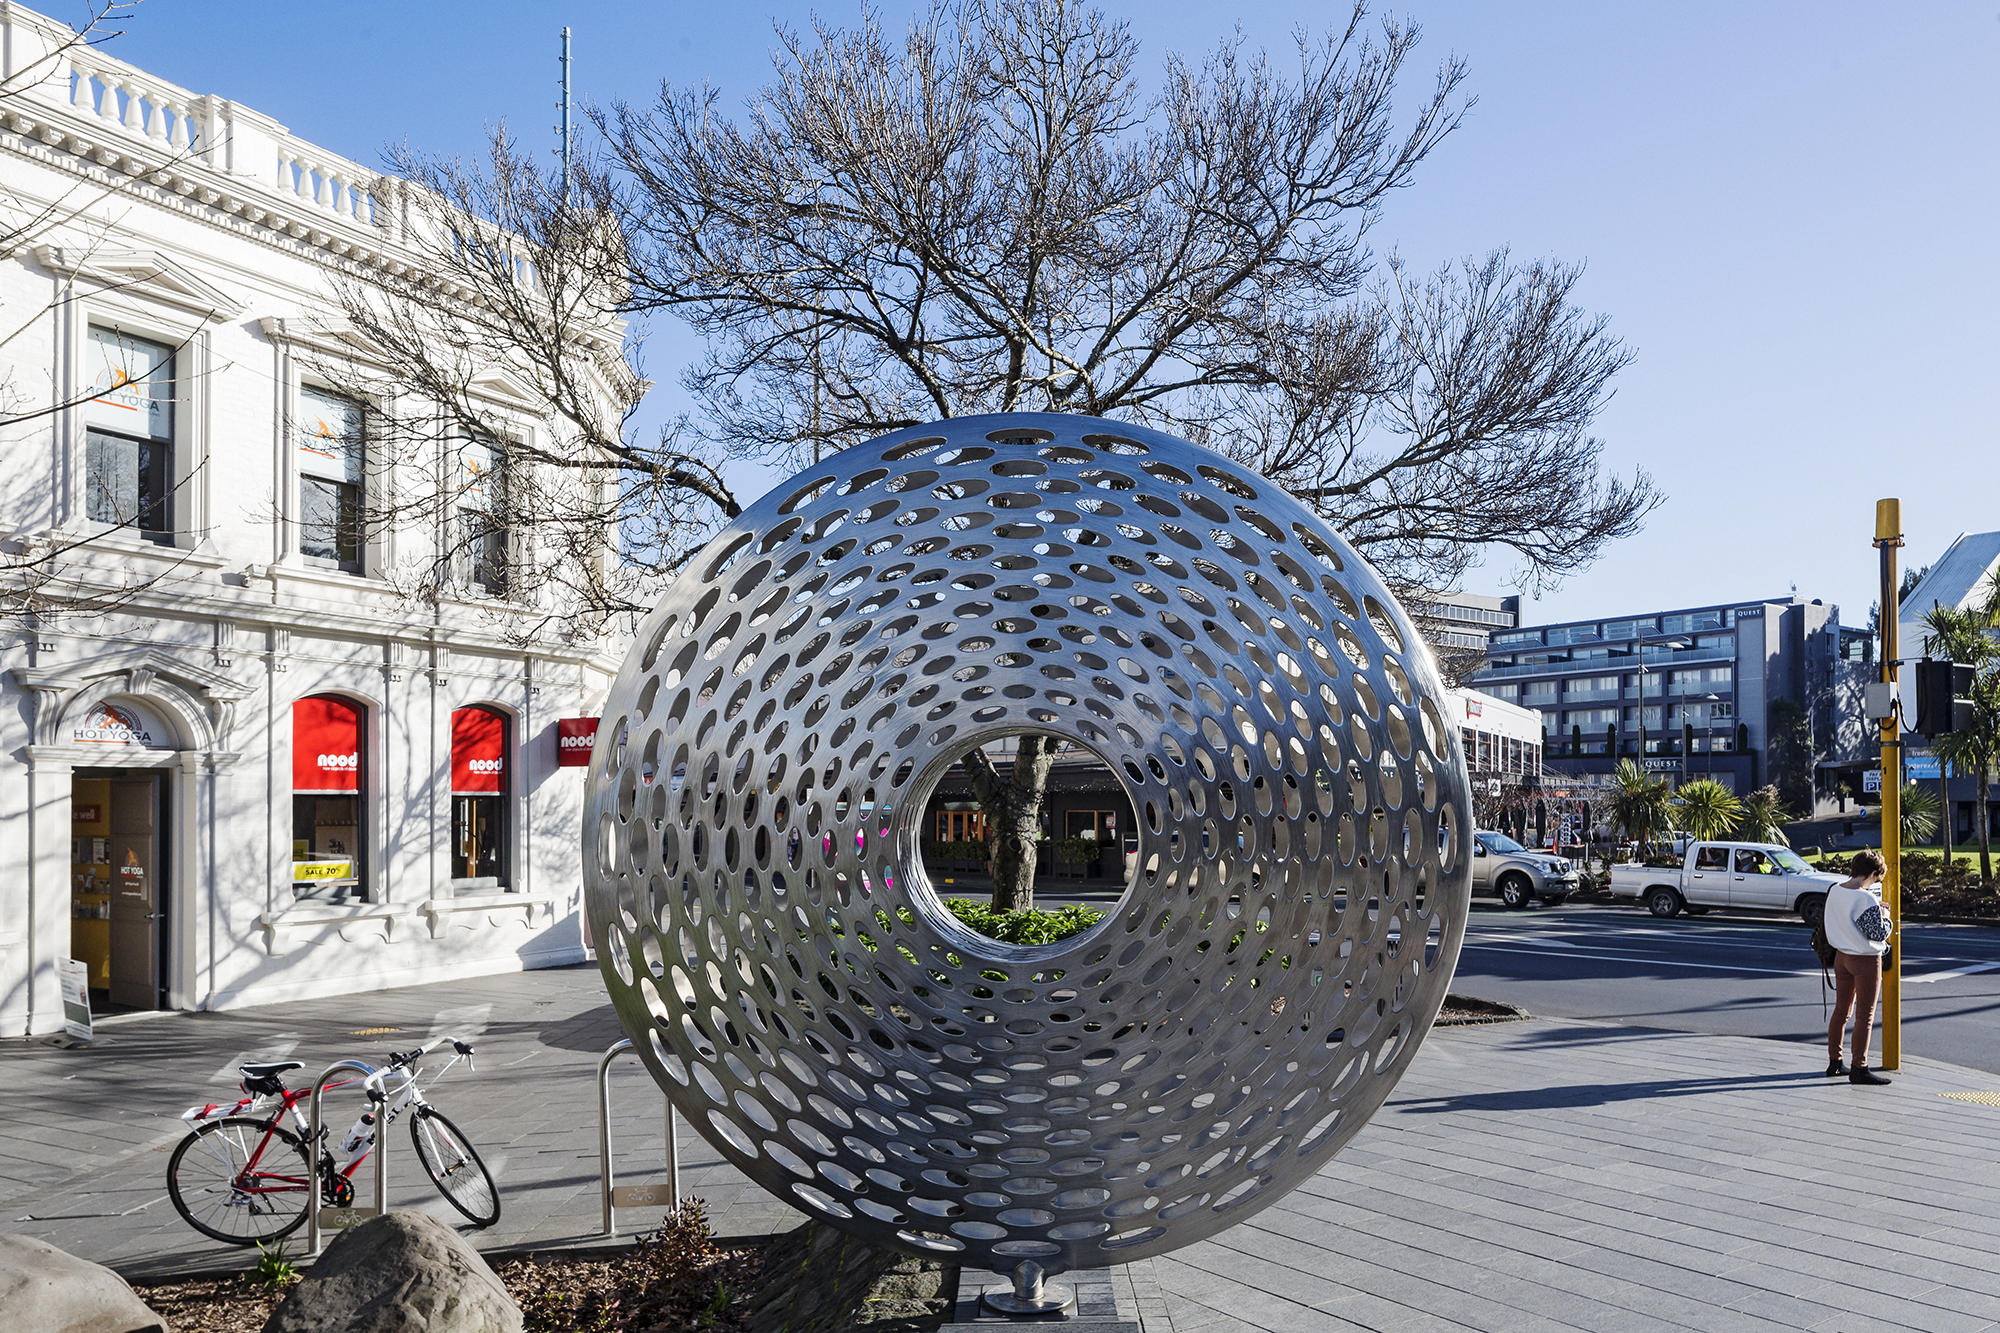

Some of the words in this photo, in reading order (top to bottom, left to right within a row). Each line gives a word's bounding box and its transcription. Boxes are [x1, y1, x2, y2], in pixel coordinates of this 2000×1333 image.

[1737, 609, 1761, 617] QUEST
[73, 729, 105, 739] HOT
[110, 729, 152, 741] YOGA
[560, 732, 595, 748] nood
[317, 752, 357, 767] nood
[469, 757, 503, 771] nood
[1645, 760, 1677, 769] QUEST
[121, 867, 131, 875] HOT
[131, 867, 144, 876] YOGA
[305, 868, 322, 876] SALE
